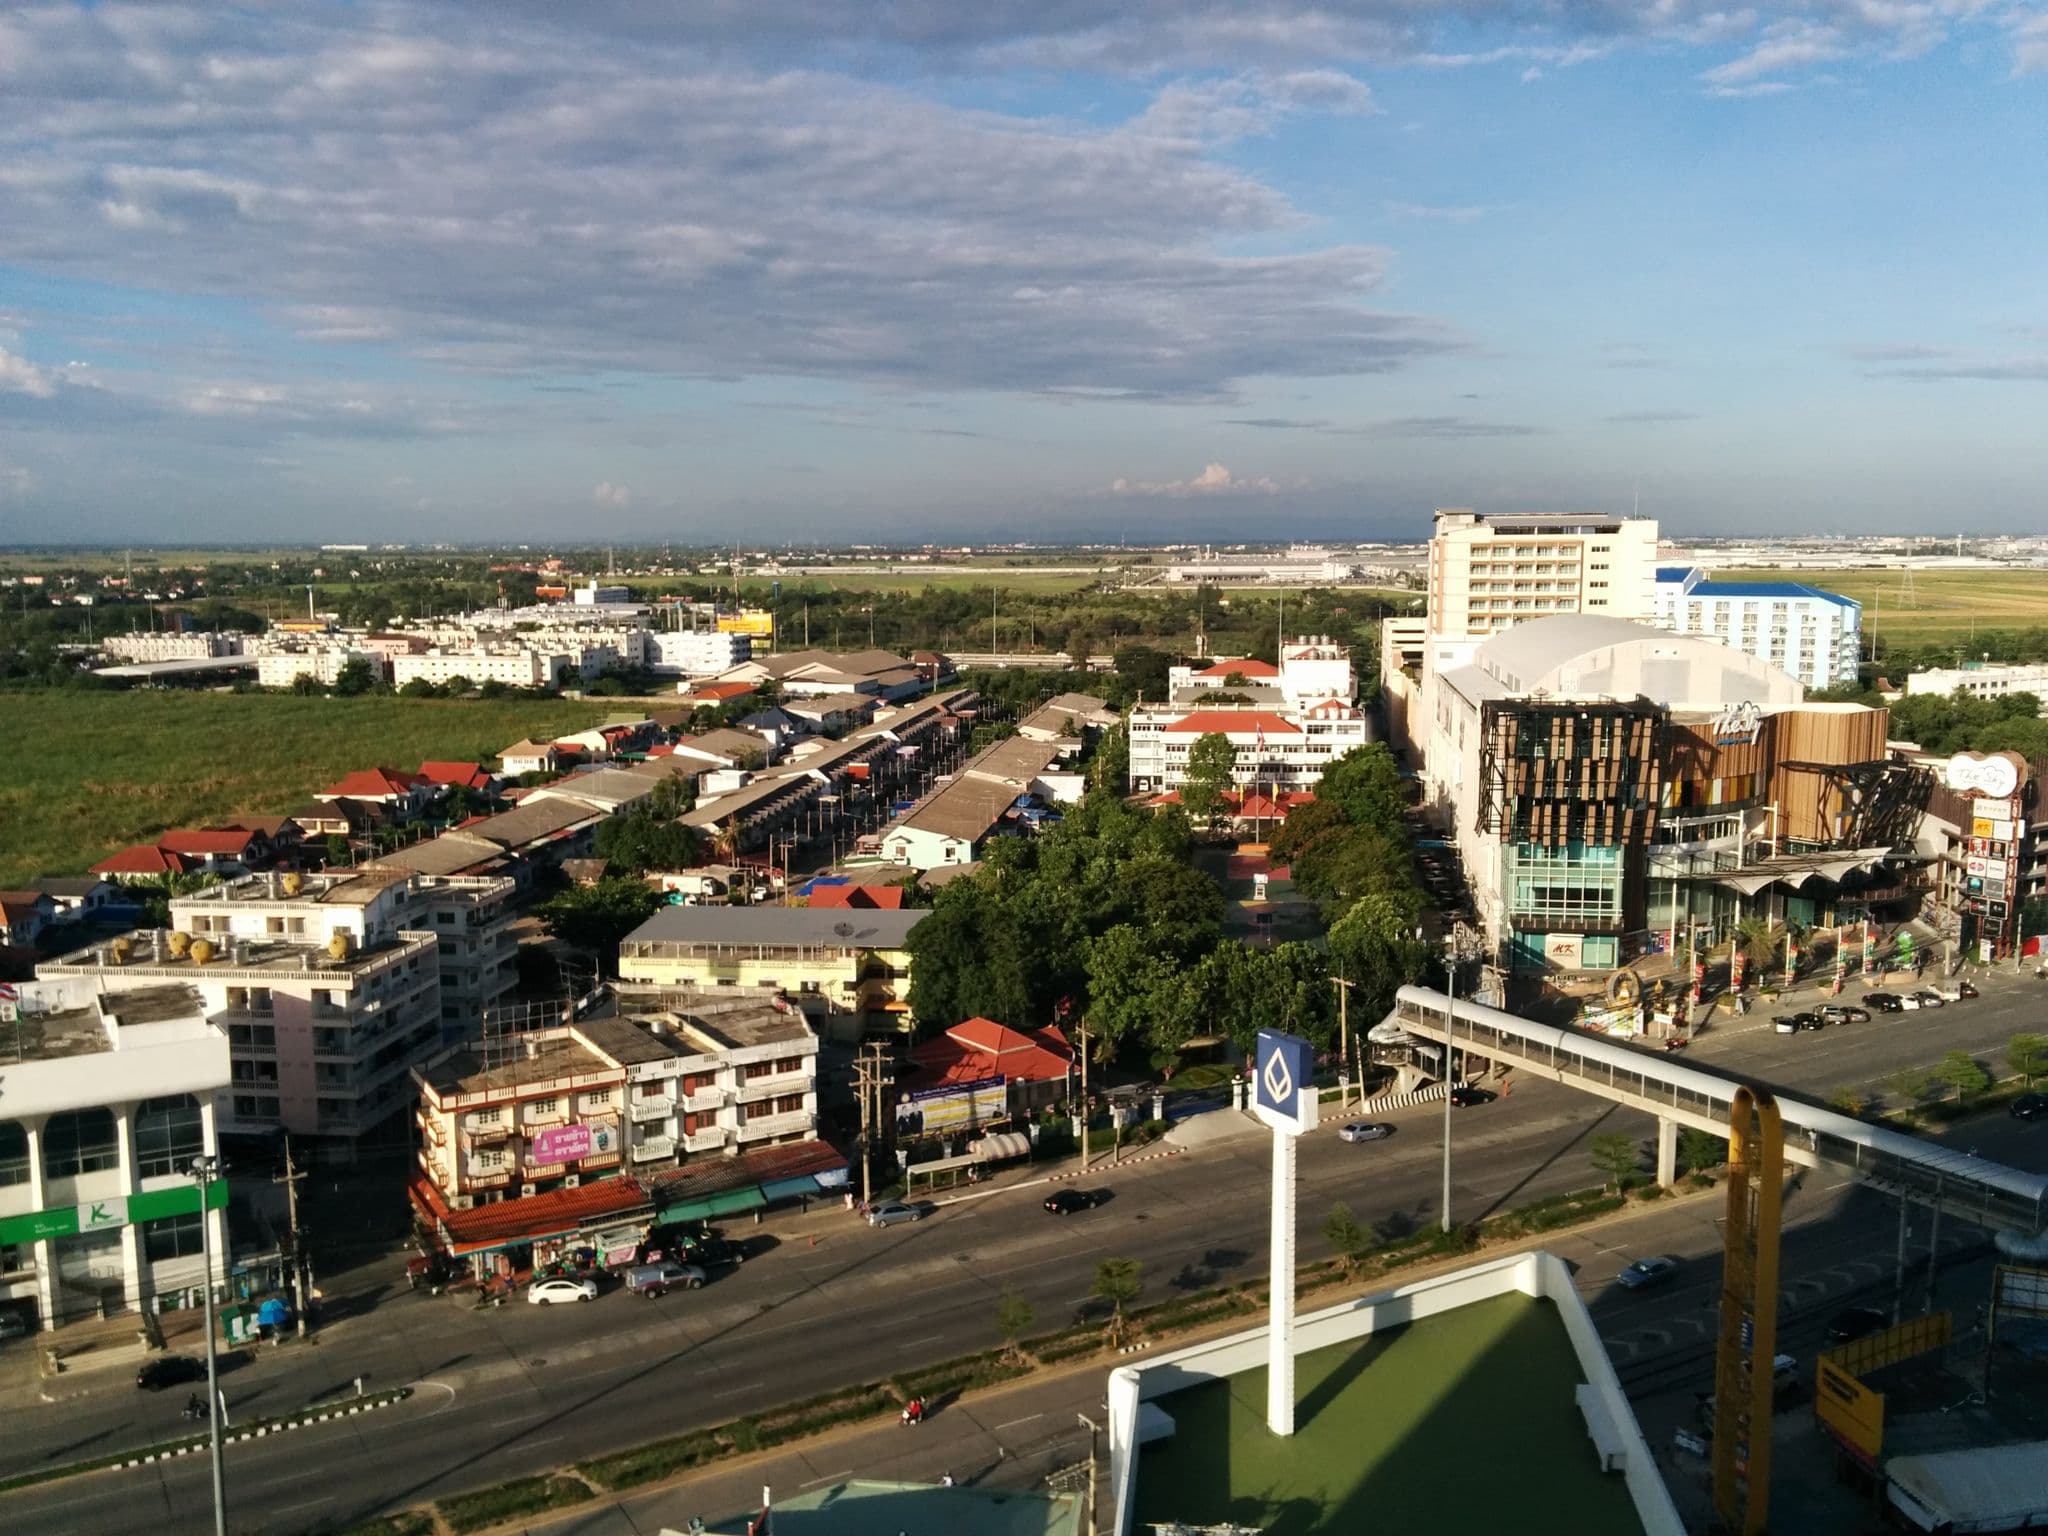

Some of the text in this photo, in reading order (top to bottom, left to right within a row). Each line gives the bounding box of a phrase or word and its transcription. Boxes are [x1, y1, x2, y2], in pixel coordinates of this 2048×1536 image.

[1713, 710, 1741, 736] The
[1959, 767, 2006, 792] The Sky
[1552, 943, 1576, 953] MK
[90, 1202, 113, 1224] K
